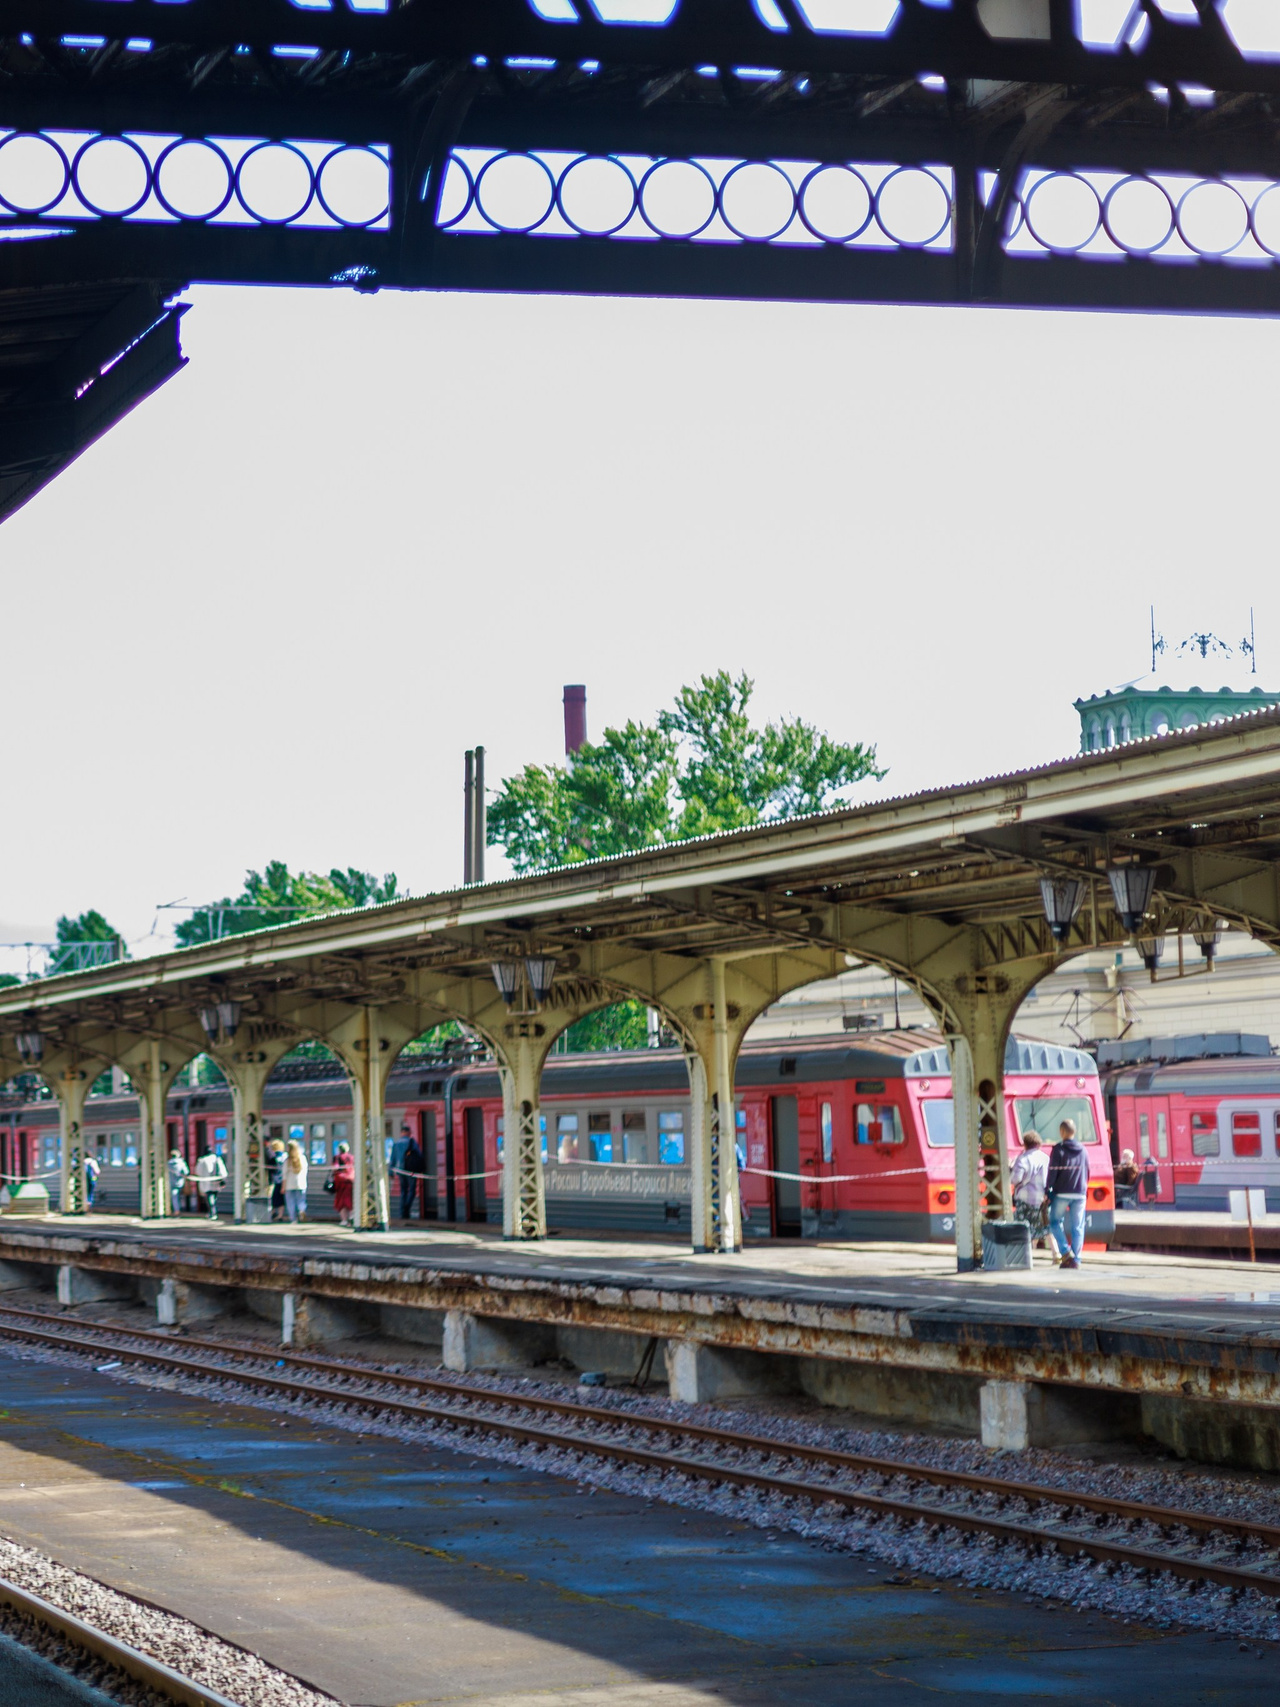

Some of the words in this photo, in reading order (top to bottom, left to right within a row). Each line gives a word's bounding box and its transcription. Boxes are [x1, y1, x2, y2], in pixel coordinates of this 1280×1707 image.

[550, 1169, 581, 1191] России
[581, 1168, 631, 1197] Воробьева
[631, 1170, 667, 1199] Бориса
